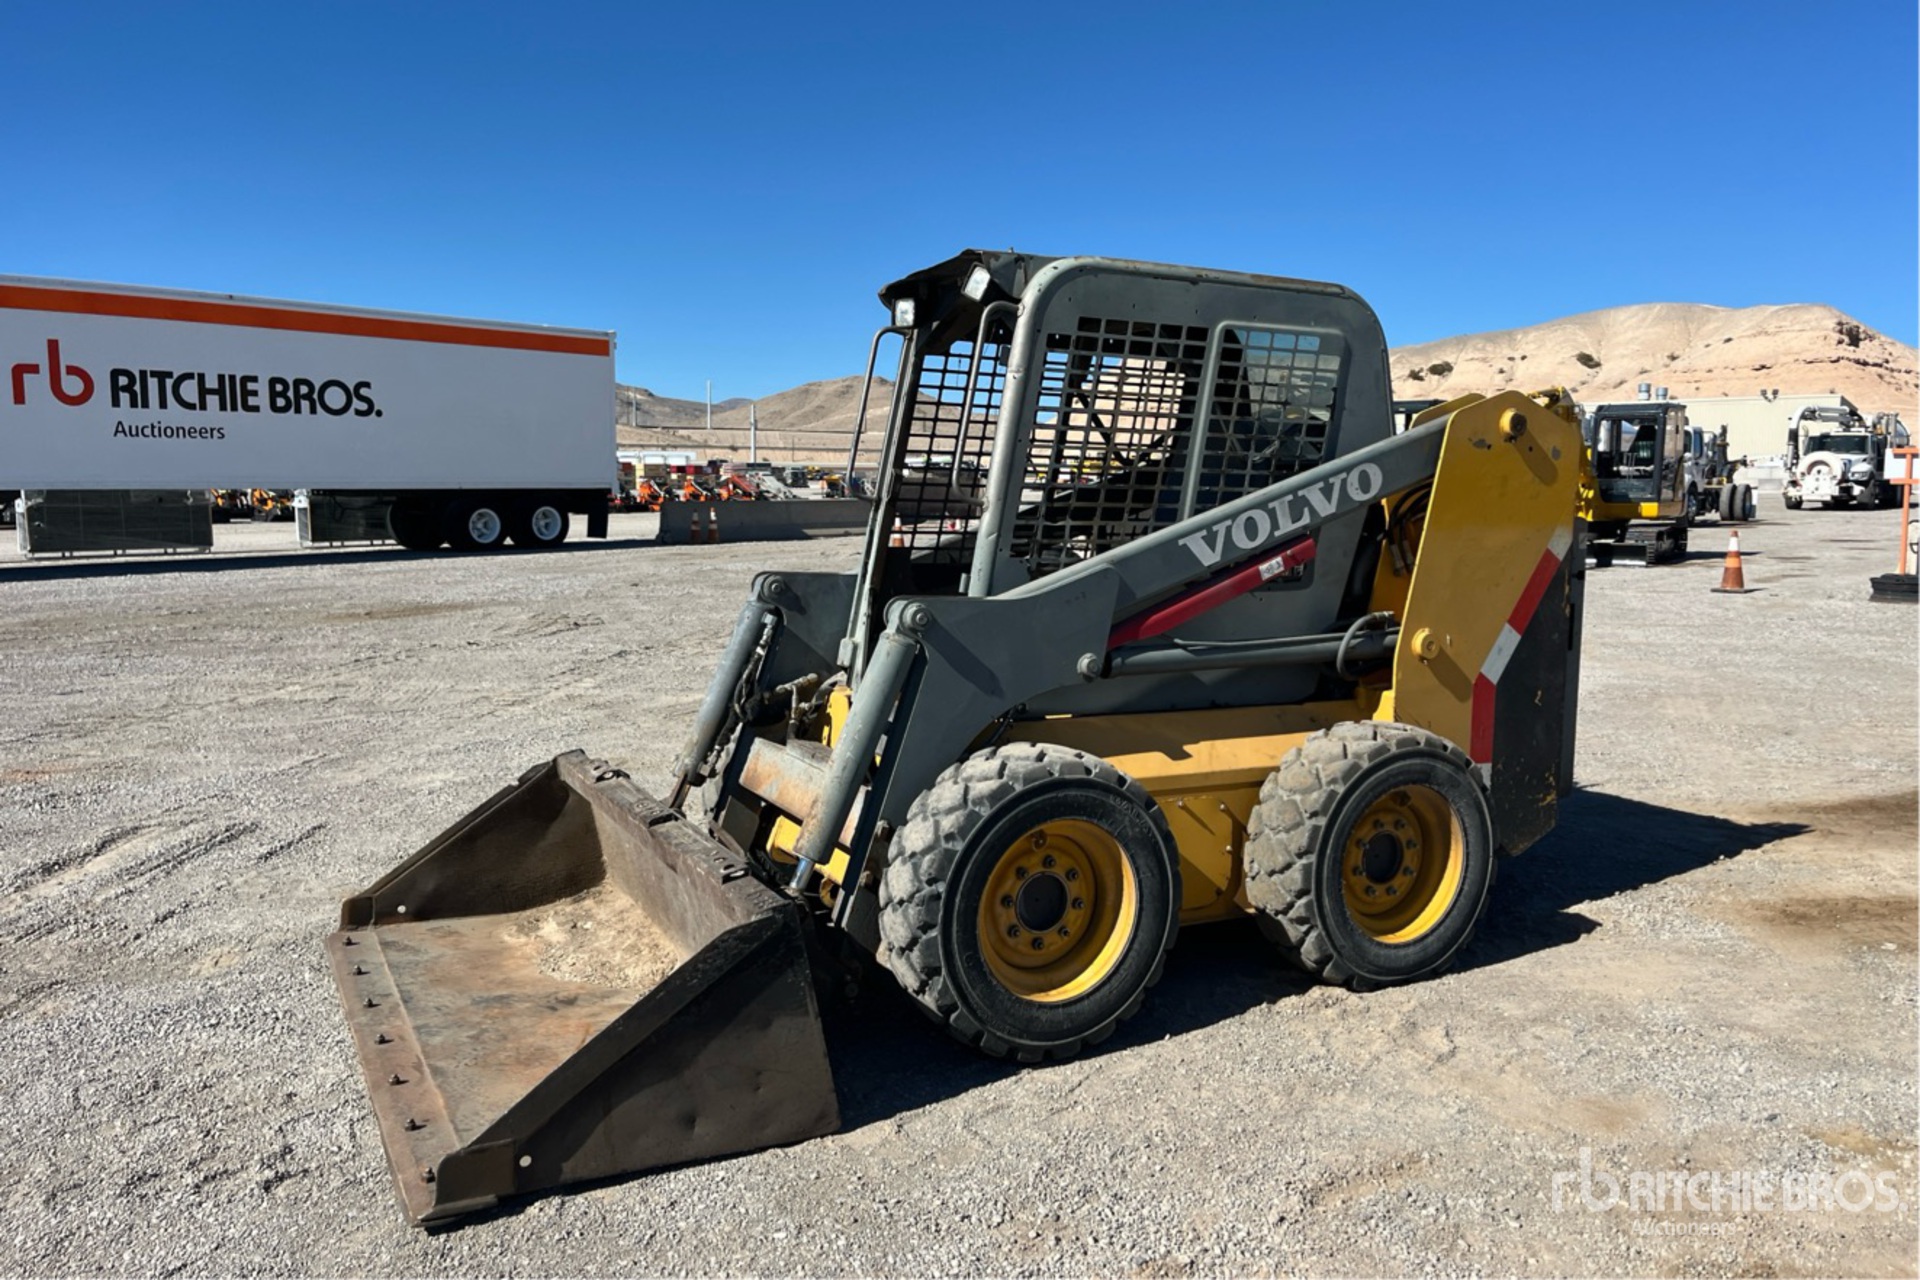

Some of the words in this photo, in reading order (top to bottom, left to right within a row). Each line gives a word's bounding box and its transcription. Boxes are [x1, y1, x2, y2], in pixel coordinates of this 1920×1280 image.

[11, 338, 94, 406] rb
[109, 368, 260, 413] RITCHIE
[268, 376, 383, 418] BROS.
[113, 420, 225, 440] Auctioneers
[1178, 462, 1383, 567] VOLVO
